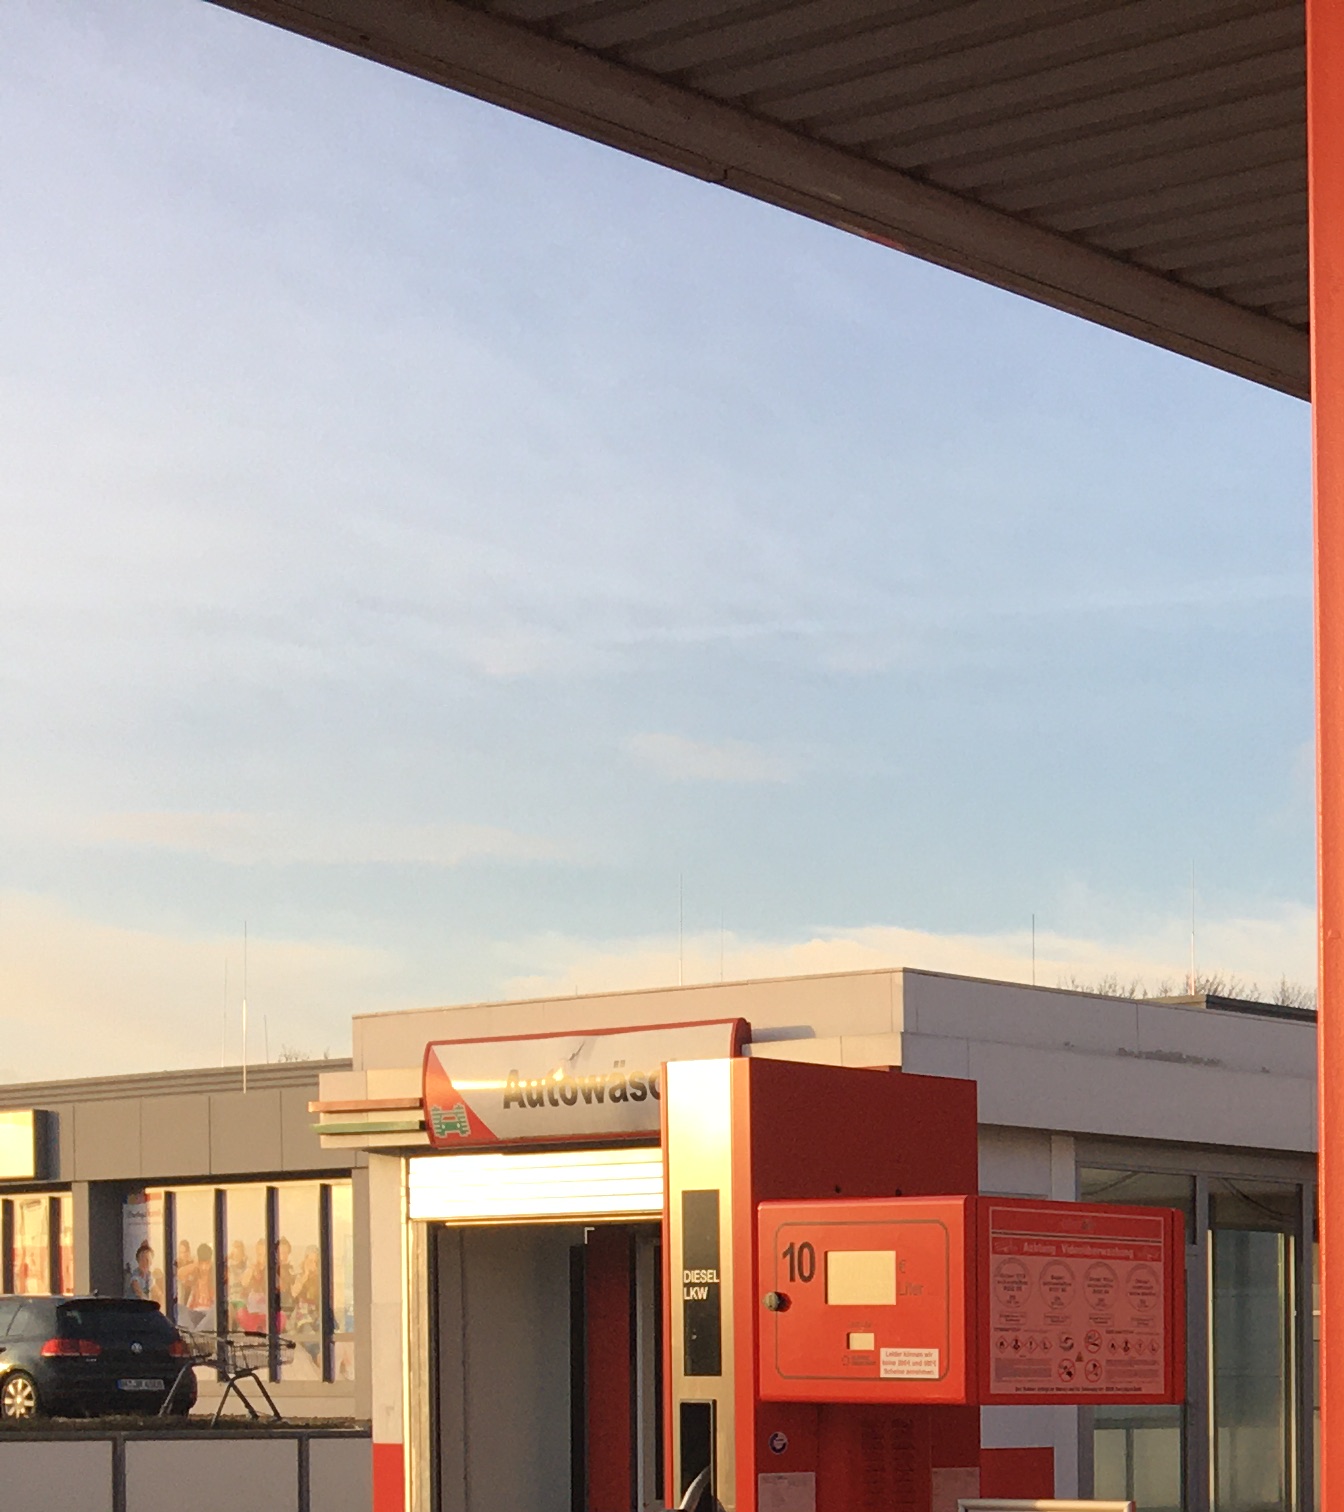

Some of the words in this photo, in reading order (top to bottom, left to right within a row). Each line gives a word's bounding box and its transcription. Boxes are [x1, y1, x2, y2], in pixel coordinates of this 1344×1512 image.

[503, 1060, 661, 1110] Autowäsc
[782, 1241, 816, 1283] 10
[683, 1269, 720, 1284] DIESEL
[683, 1286, 709, 1300] LKW
